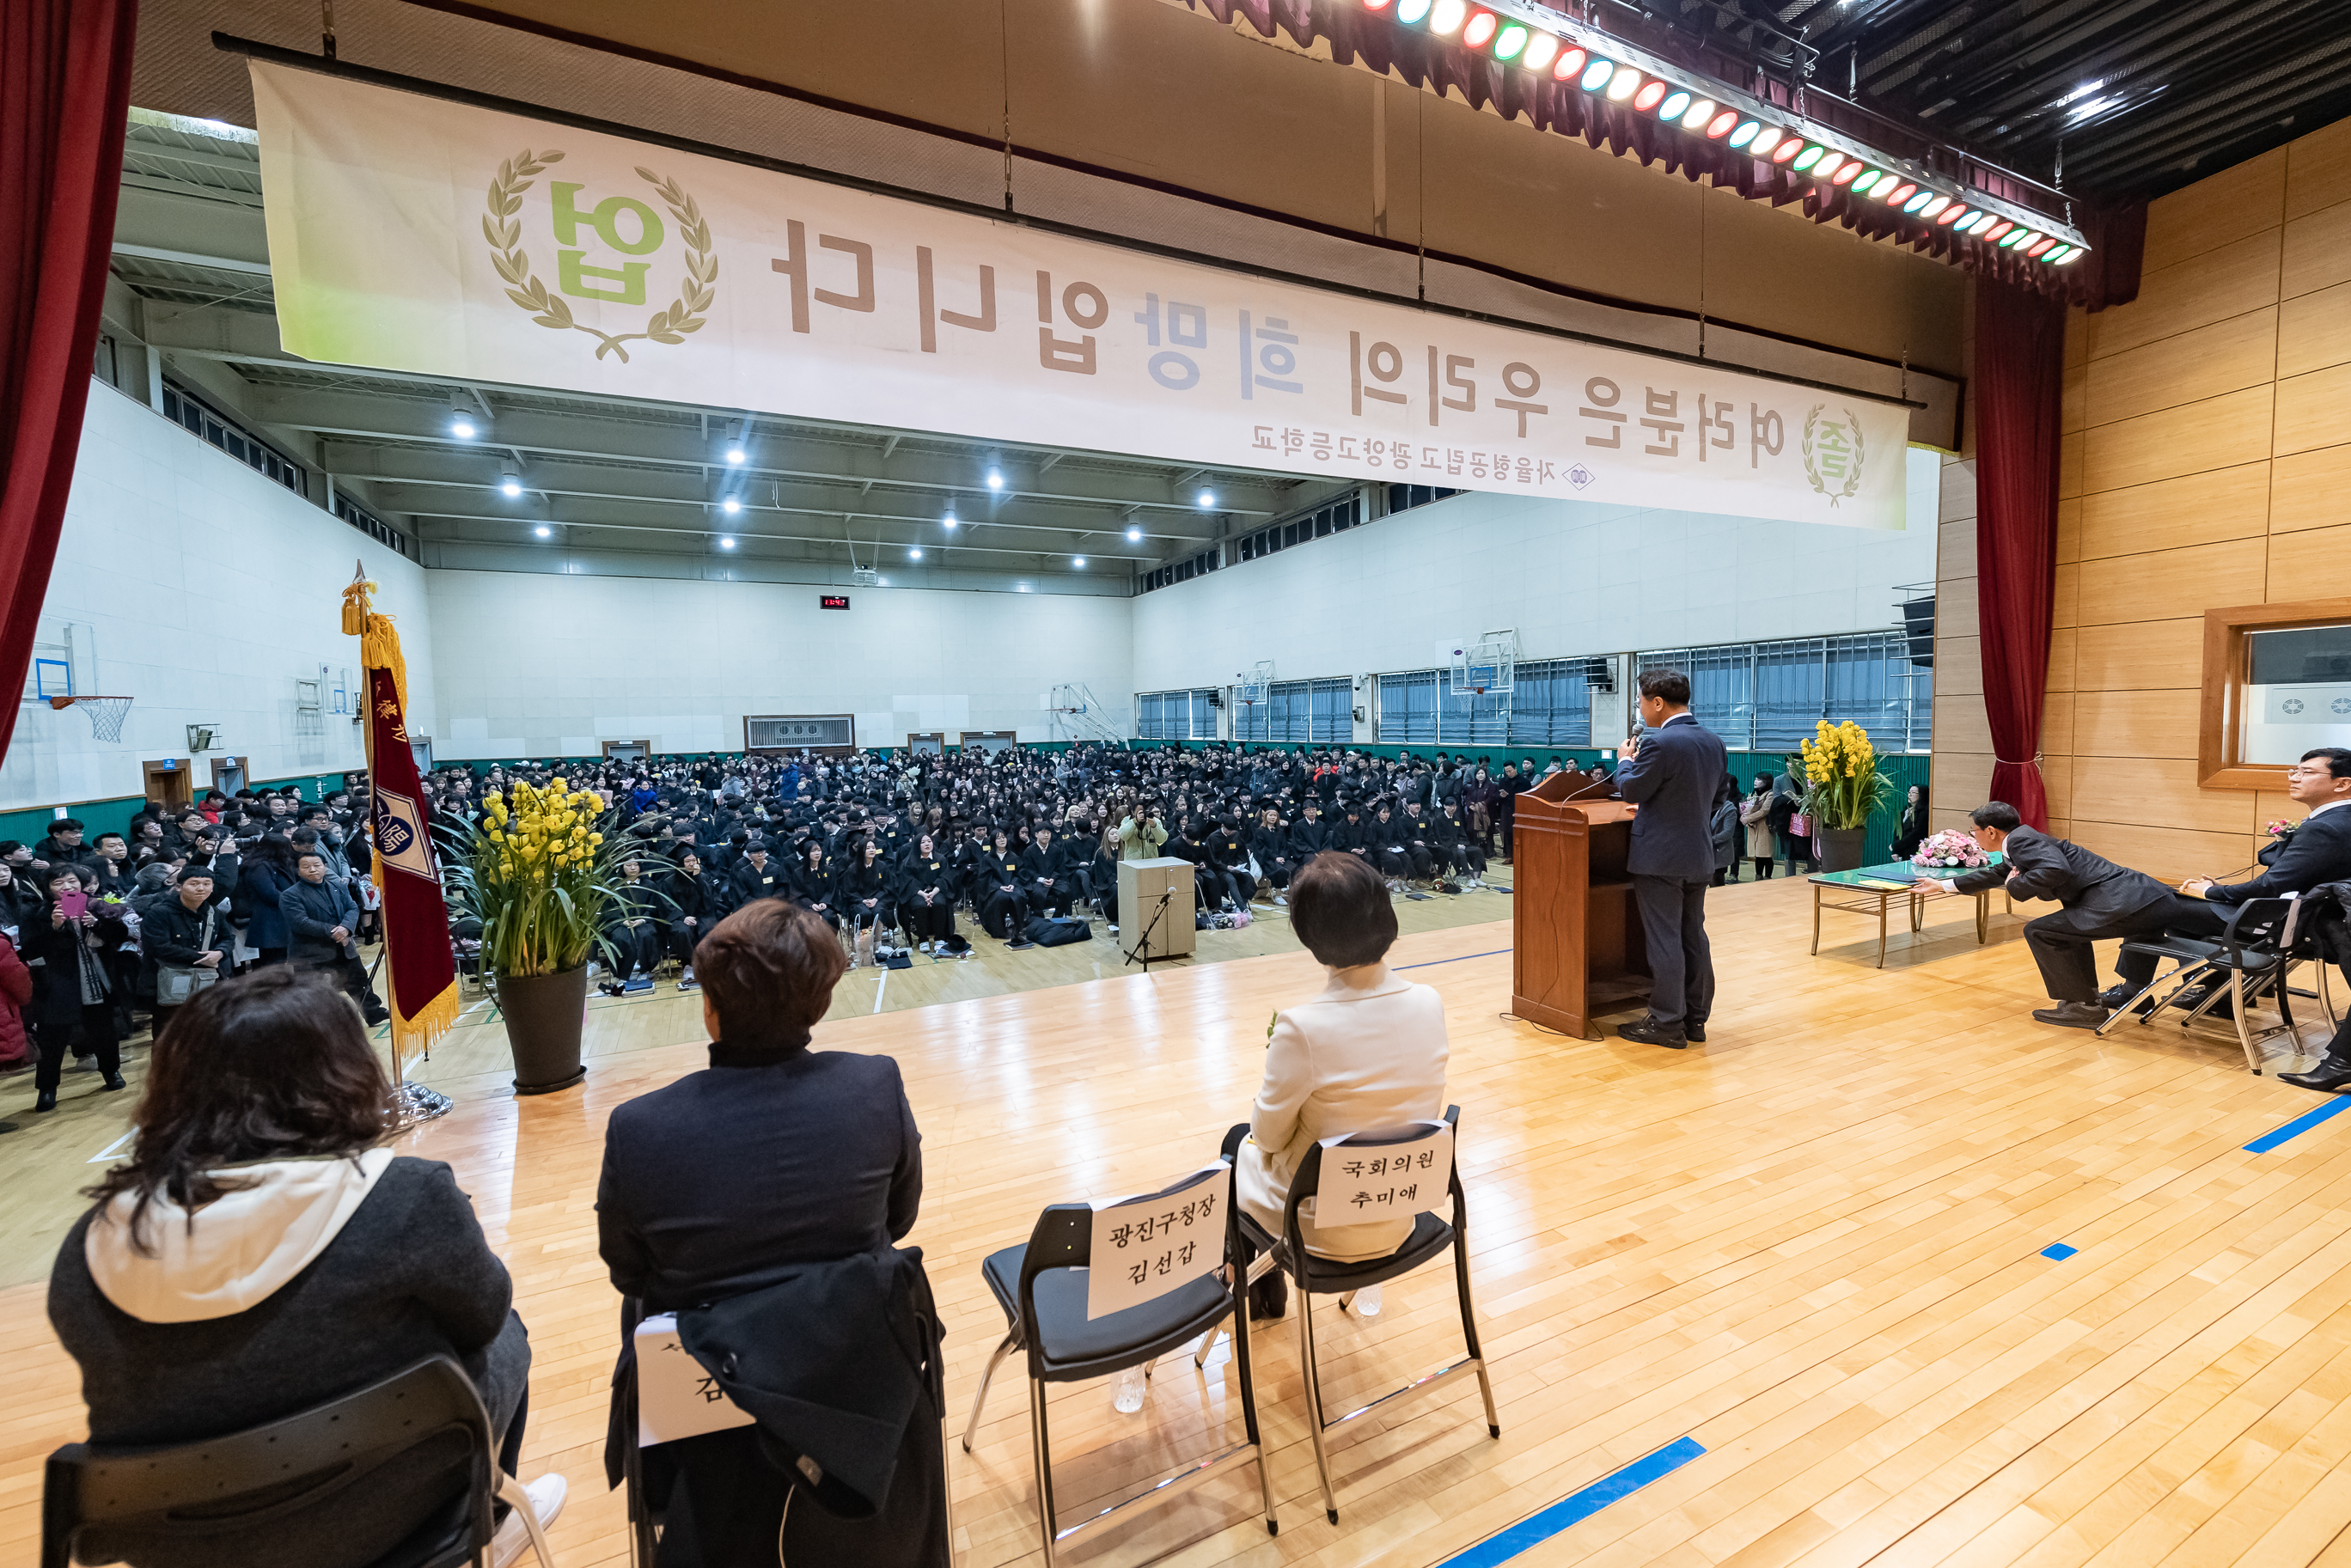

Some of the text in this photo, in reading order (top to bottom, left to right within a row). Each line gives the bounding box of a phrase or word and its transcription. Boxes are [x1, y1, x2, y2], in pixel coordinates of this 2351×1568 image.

[1341, 1150, 1434, 1179] 국회의원
[1350, 1183, 1418, 1209] 추미애
[1108, 1193, 1217, 1248] 광진구청장
[1127, 1241, 1197, 1285] 김선갑
